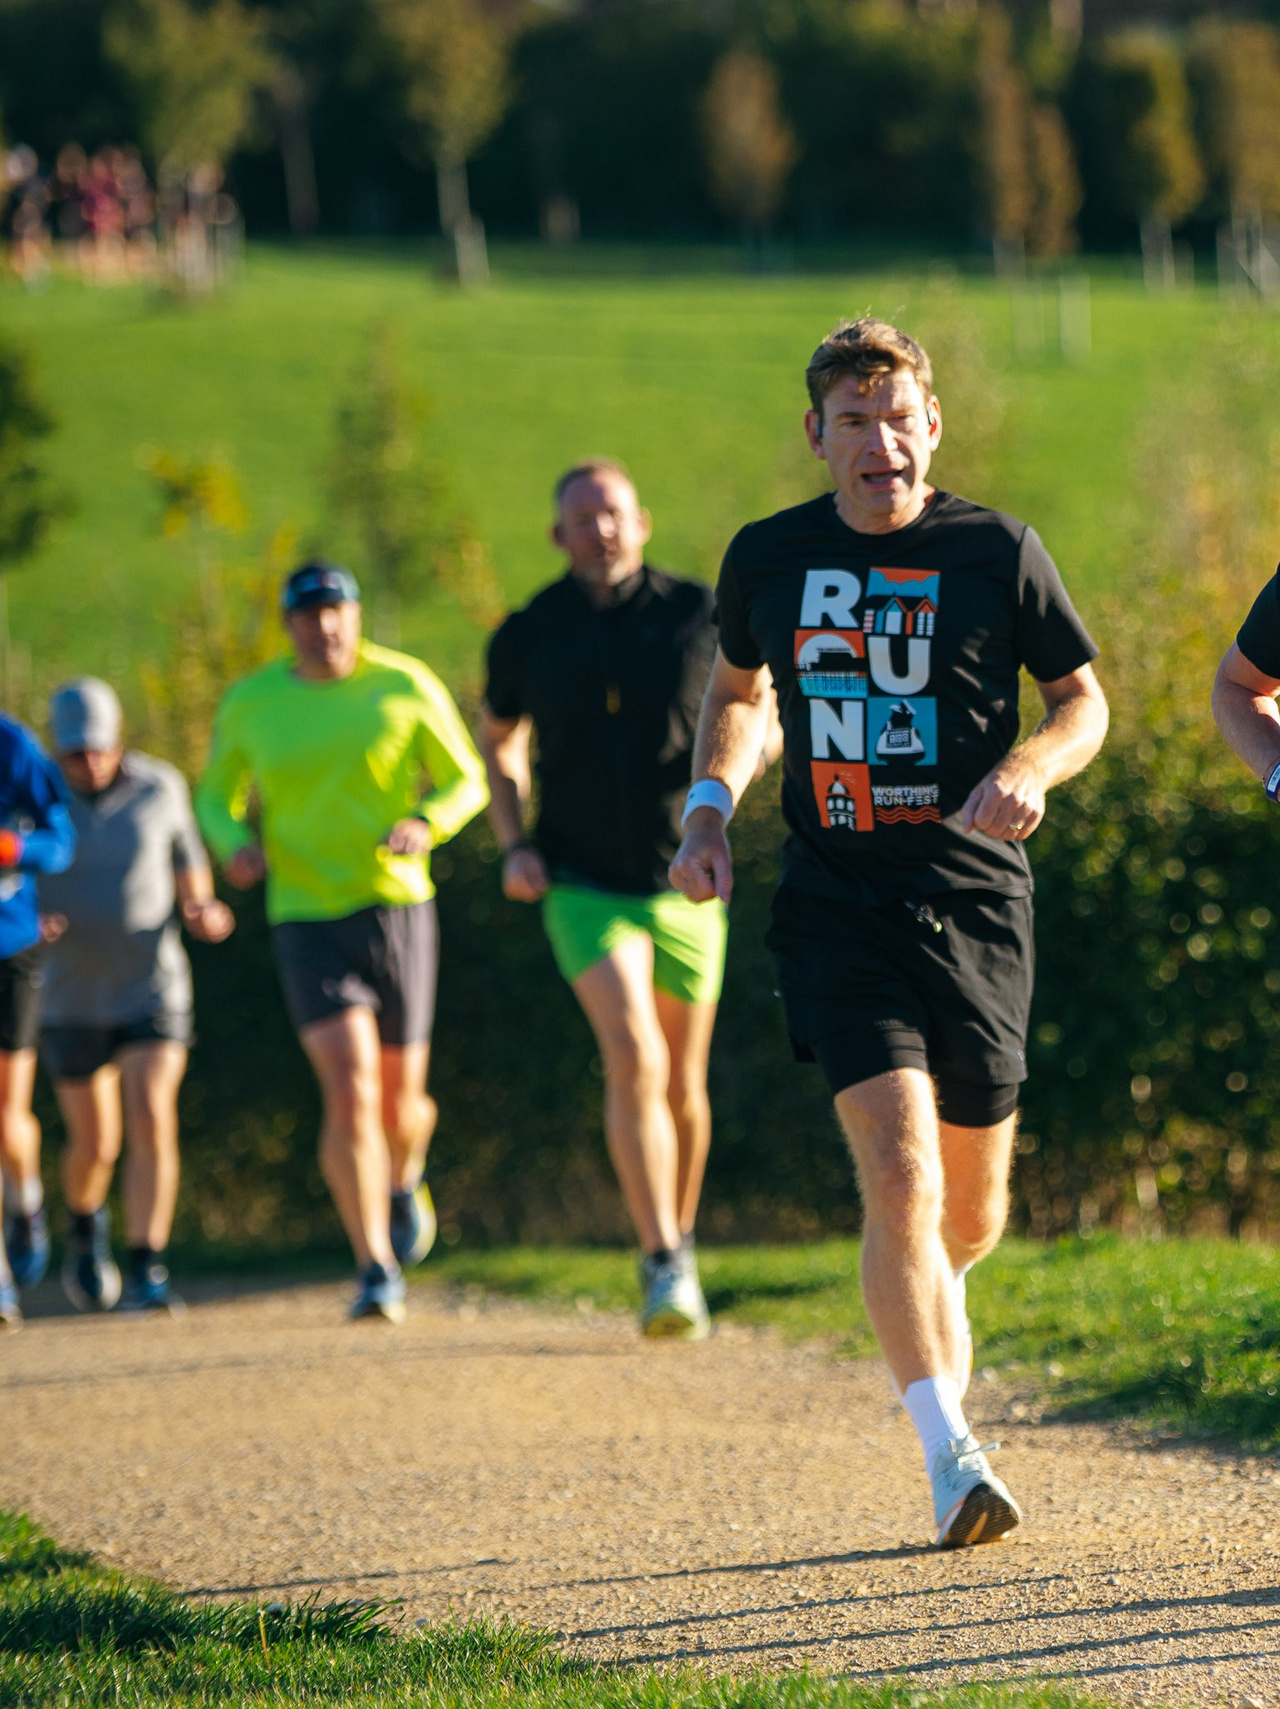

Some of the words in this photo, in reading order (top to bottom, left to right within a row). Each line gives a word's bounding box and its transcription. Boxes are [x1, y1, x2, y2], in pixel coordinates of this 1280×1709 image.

[799, 569, 862, 628] R
[867, 635, 932, 696] U
[809, 698, 865, 759] N
[871, 784, 940, 797] WORTHING
[874, 795, 939, 806] RUN-FEST
